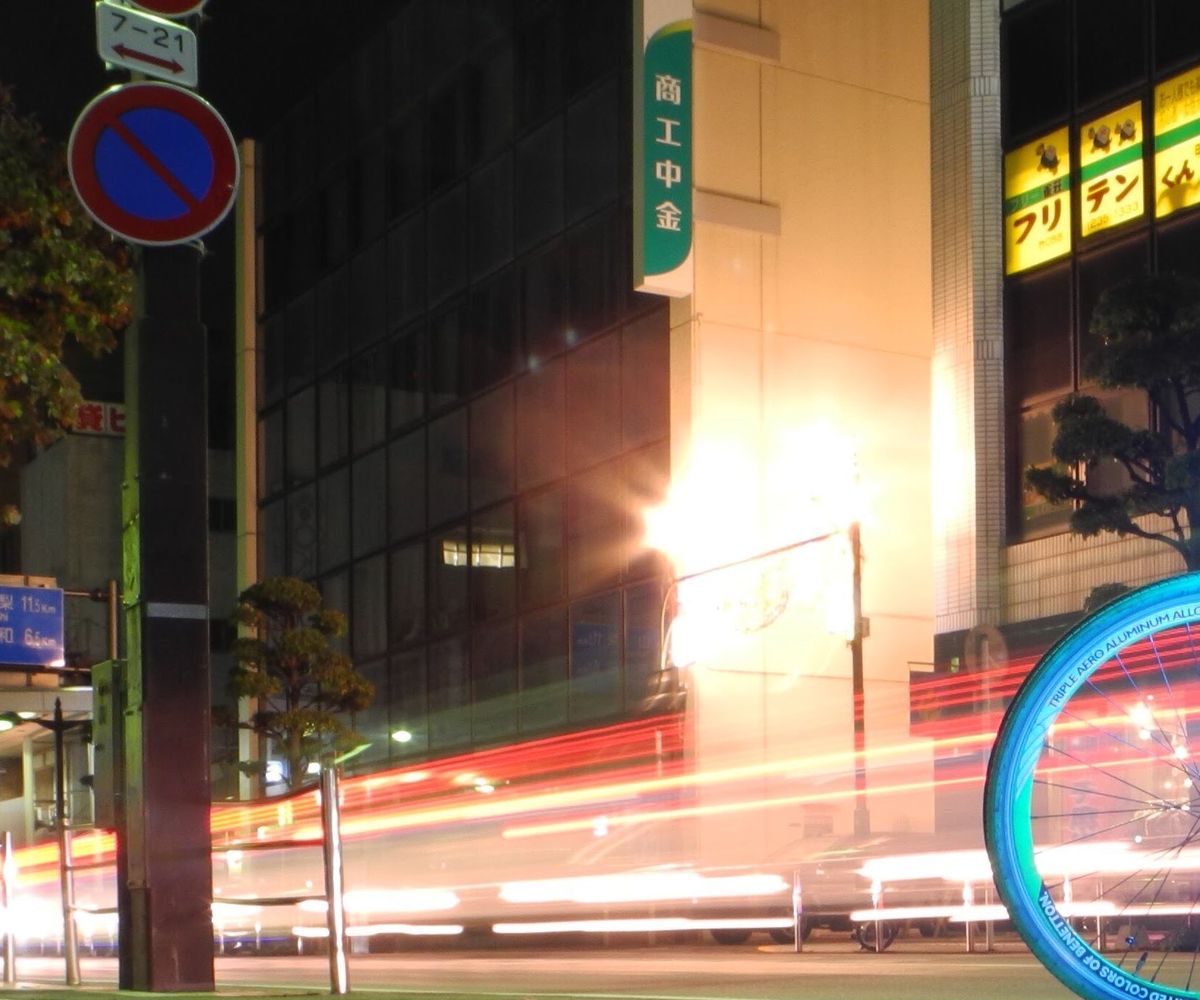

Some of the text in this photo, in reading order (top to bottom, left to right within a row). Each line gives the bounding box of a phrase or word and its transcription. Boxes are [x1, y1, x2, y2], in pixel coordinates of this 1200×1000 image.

[111, 12, 183, 53] 7-21
[655, 74, 681, 232] 商工中金
[1049, 674, 1079, 708] TRIPLE
[1077, 649, 1105, 676] AERO
[1106, 613, 1170, 652] ALUMINUM
[1083, 955, 1100, 971] OF
[1100, 965, 1149, 998] COLORS
